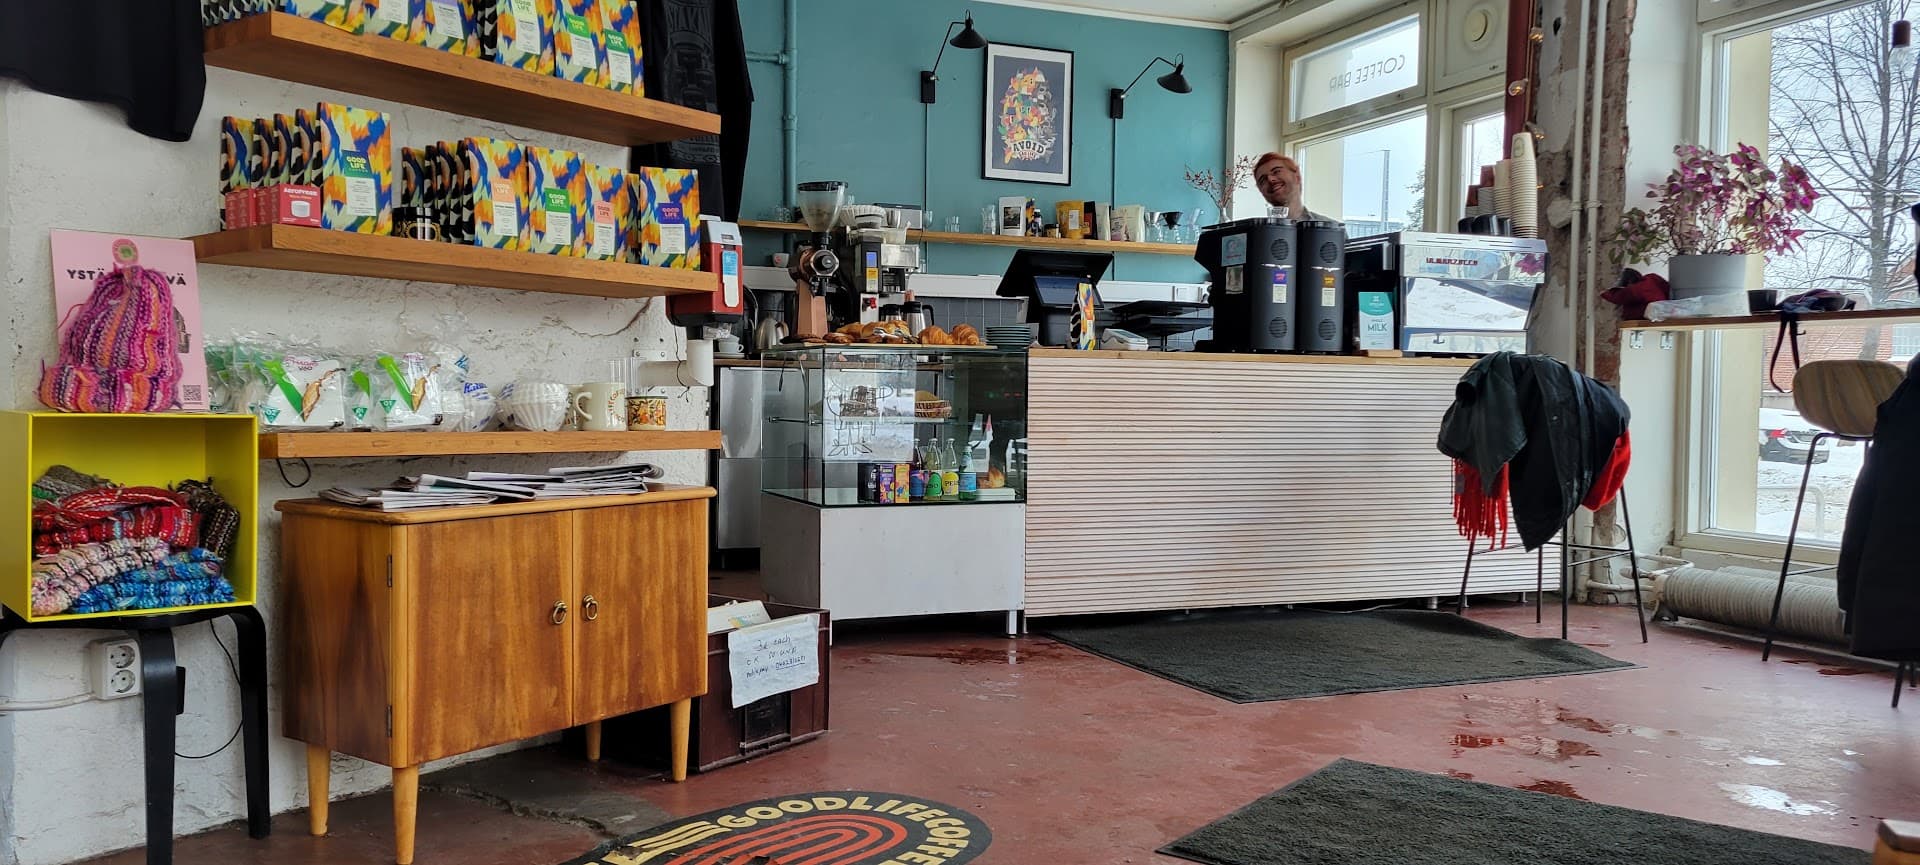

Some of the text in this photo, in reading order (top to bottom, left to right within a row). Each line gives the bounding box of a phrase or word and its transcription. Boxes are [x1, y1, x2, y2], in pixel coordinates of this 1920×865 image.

[1013, 140, 1044, 154] AVOID
[346, 156, 367, 164] GOOD
[350, 162, 366, 170] LIFE
[1367, 323, 1388, 332] MILK
